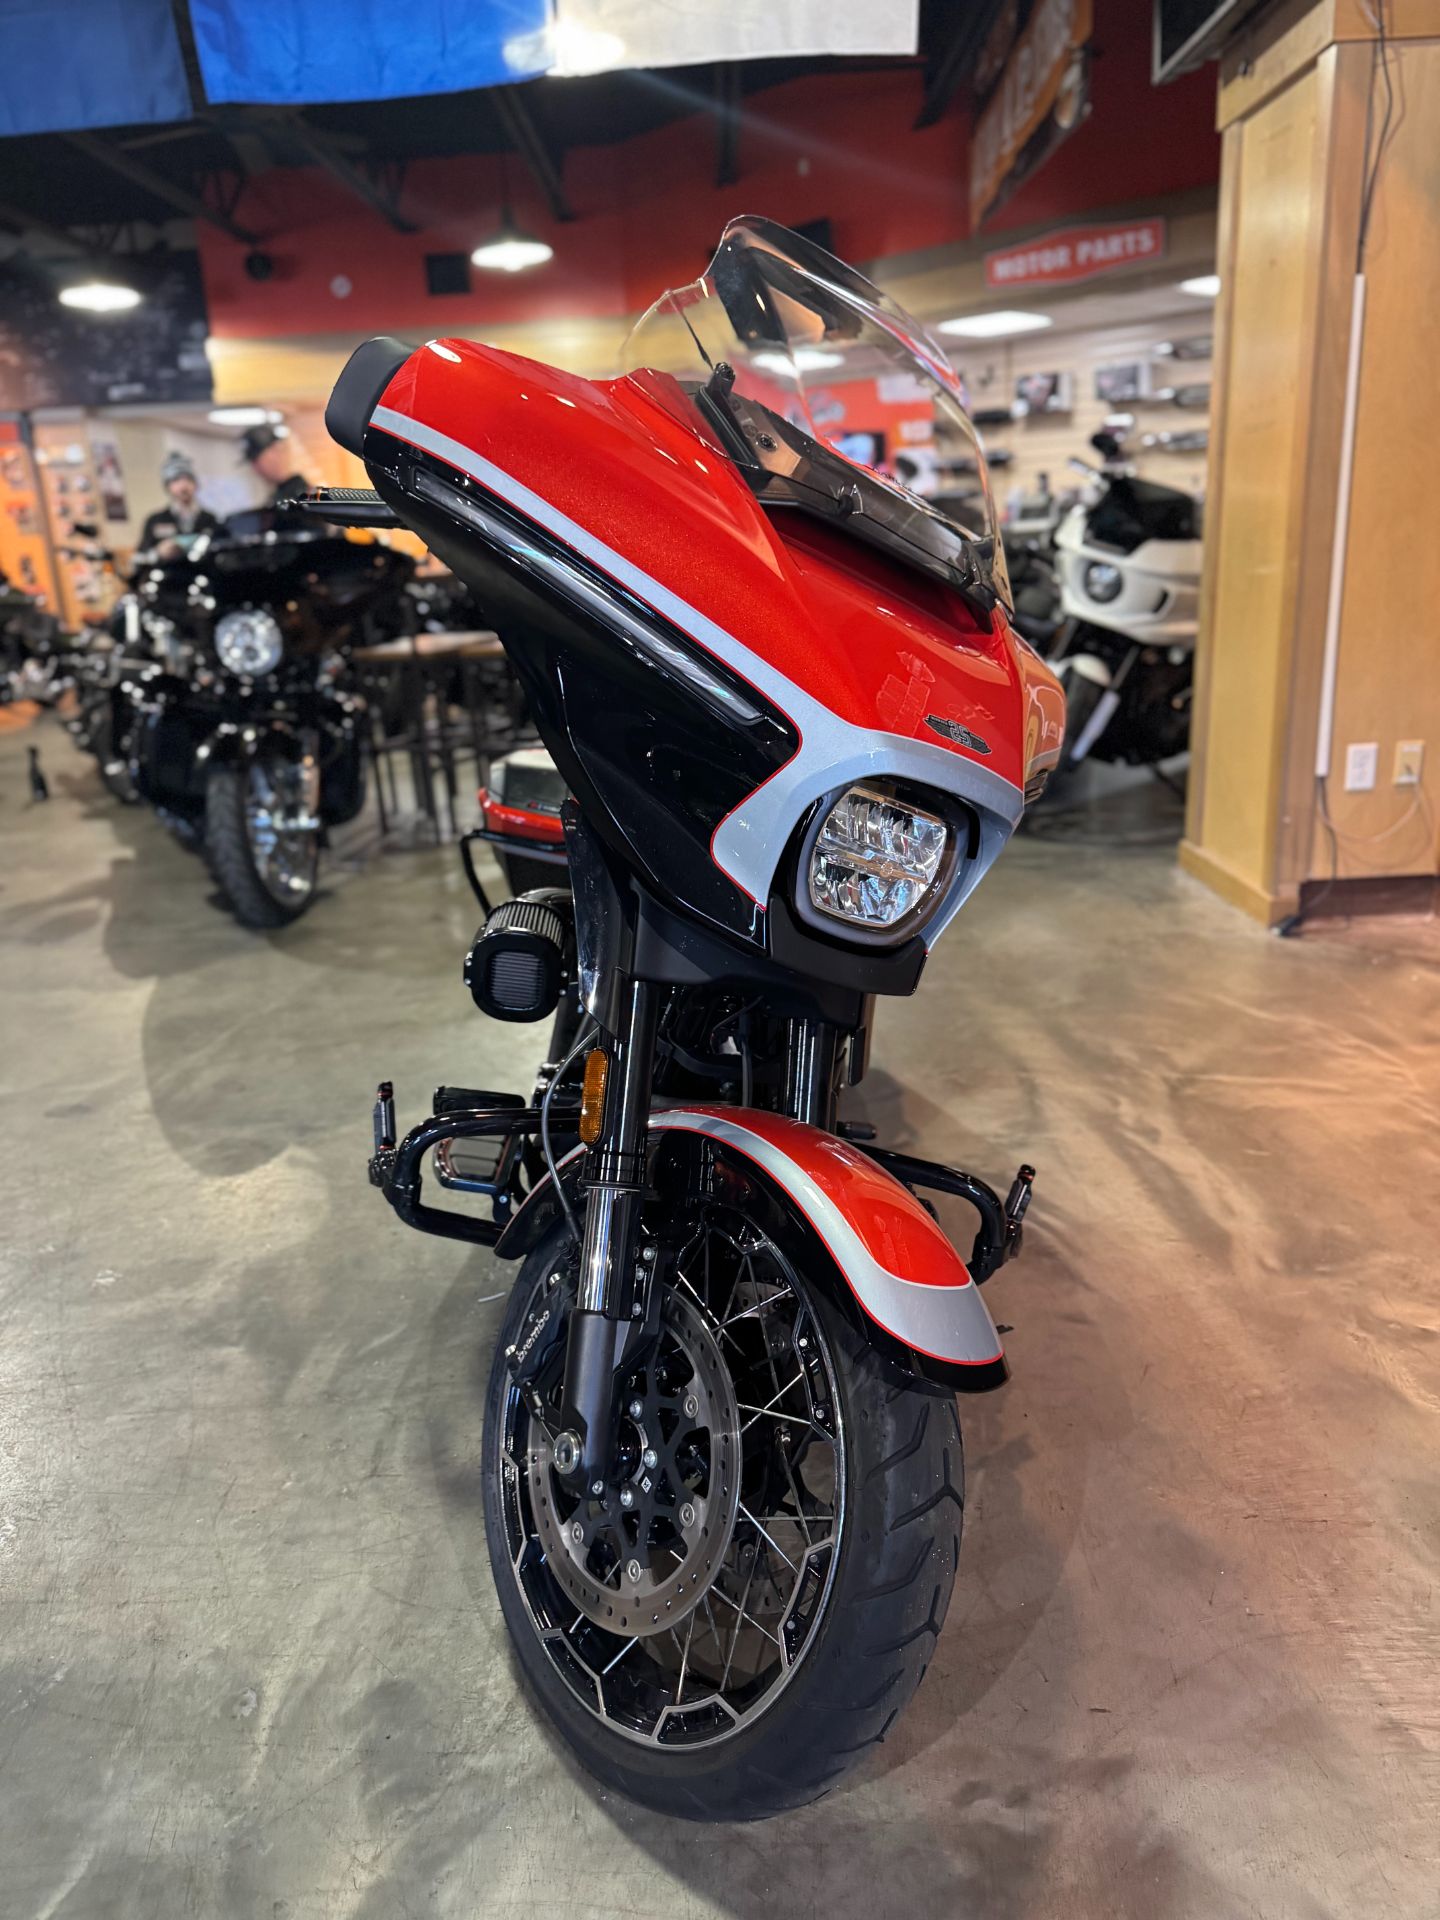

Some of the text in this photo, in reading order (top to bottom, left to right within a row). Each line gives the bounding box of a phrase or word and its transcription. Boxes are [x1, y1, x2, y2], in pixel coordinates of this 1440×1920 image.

[993, 228, 1153, 280] MOTOR PARTS
[515, 1310, 550, 1363] brembo
